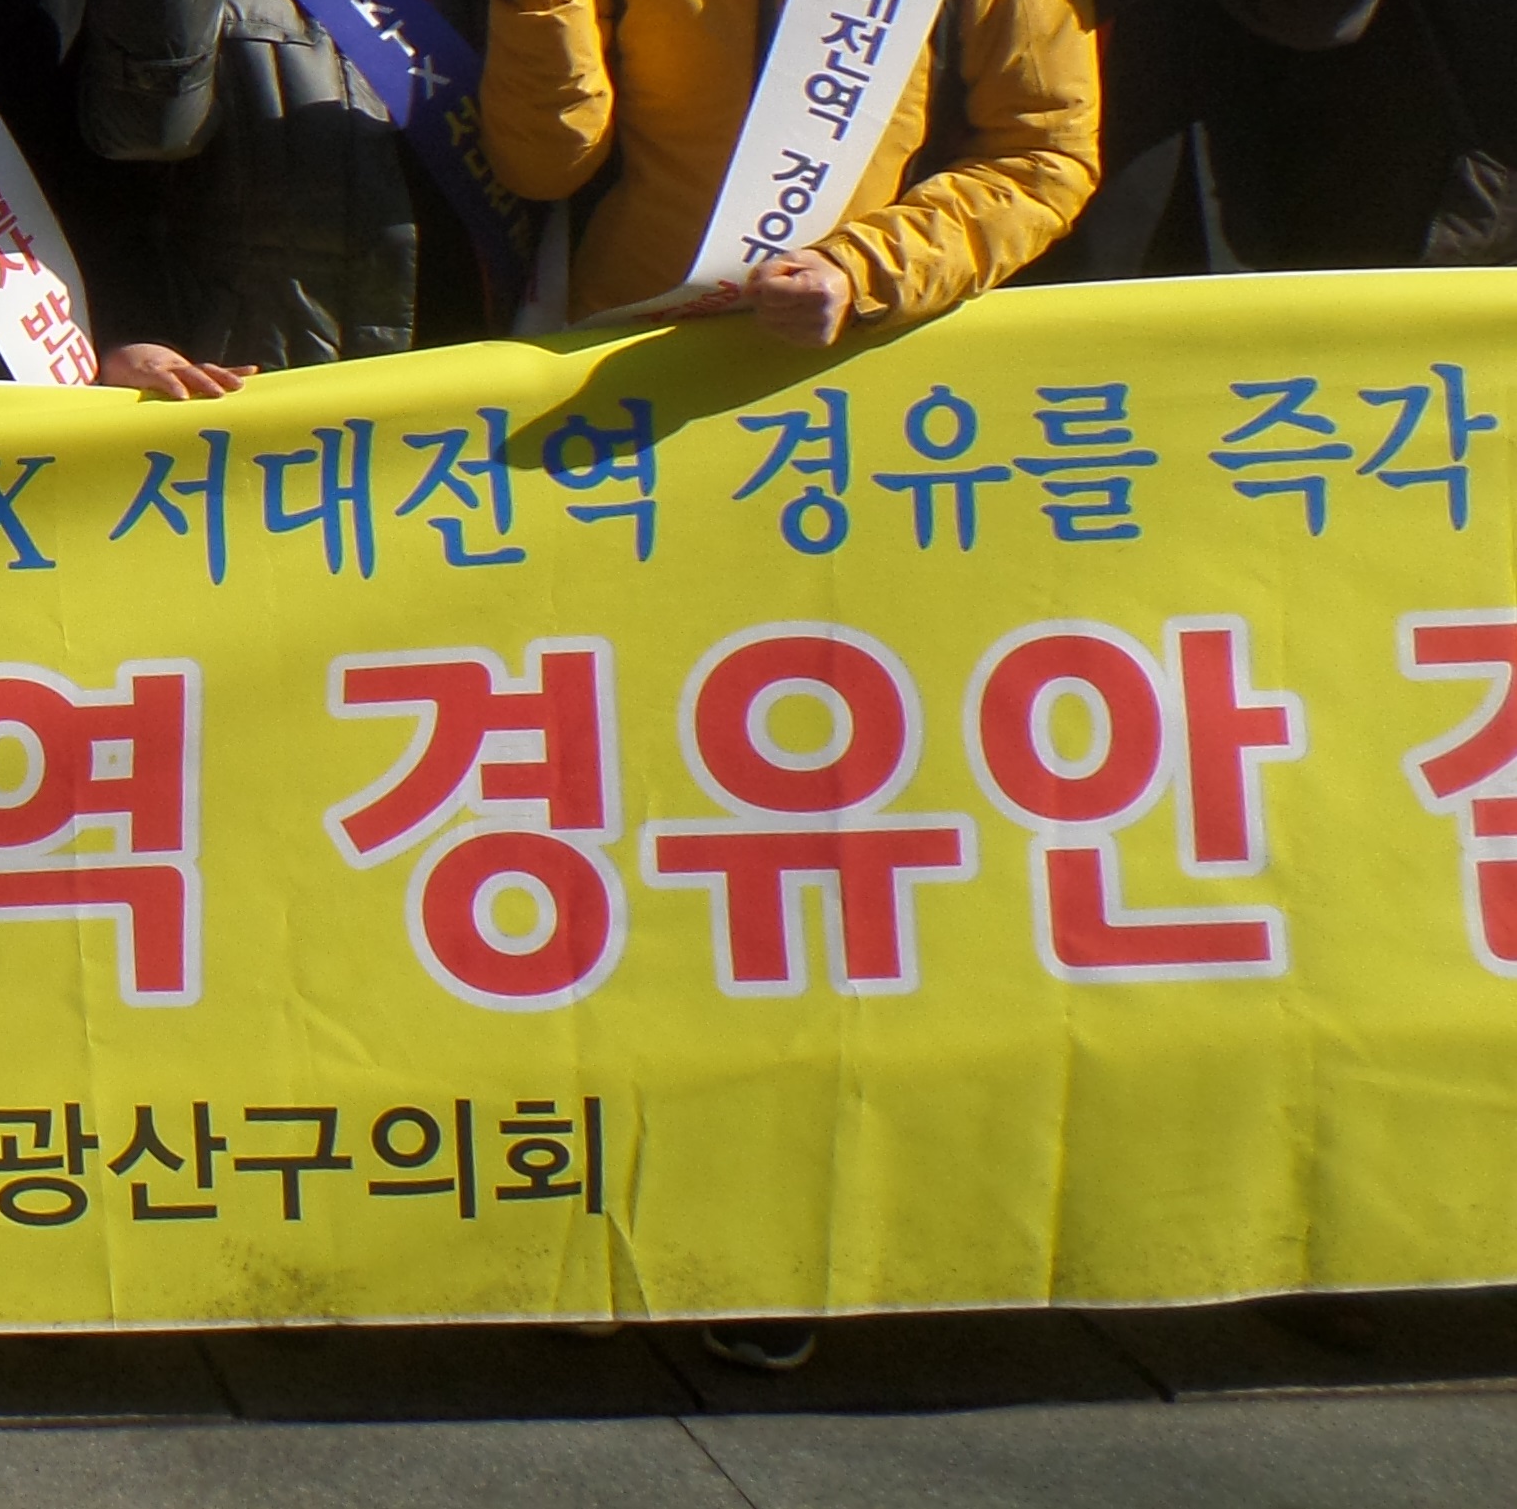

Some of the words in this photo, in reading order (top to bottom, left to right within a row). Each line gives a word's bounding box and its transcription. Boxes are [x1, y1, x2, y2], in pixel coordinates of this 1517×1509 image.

[740, 148, 831, 264] 경유
[20, 289, 99, 386] 반대
[108, 395, 659, 586] 서대전역
[732, 381, 1160, 555] 경유를
[1209, 363, 1499, 537] 즉각
[330, 620, 1301, 1006] 경유안
